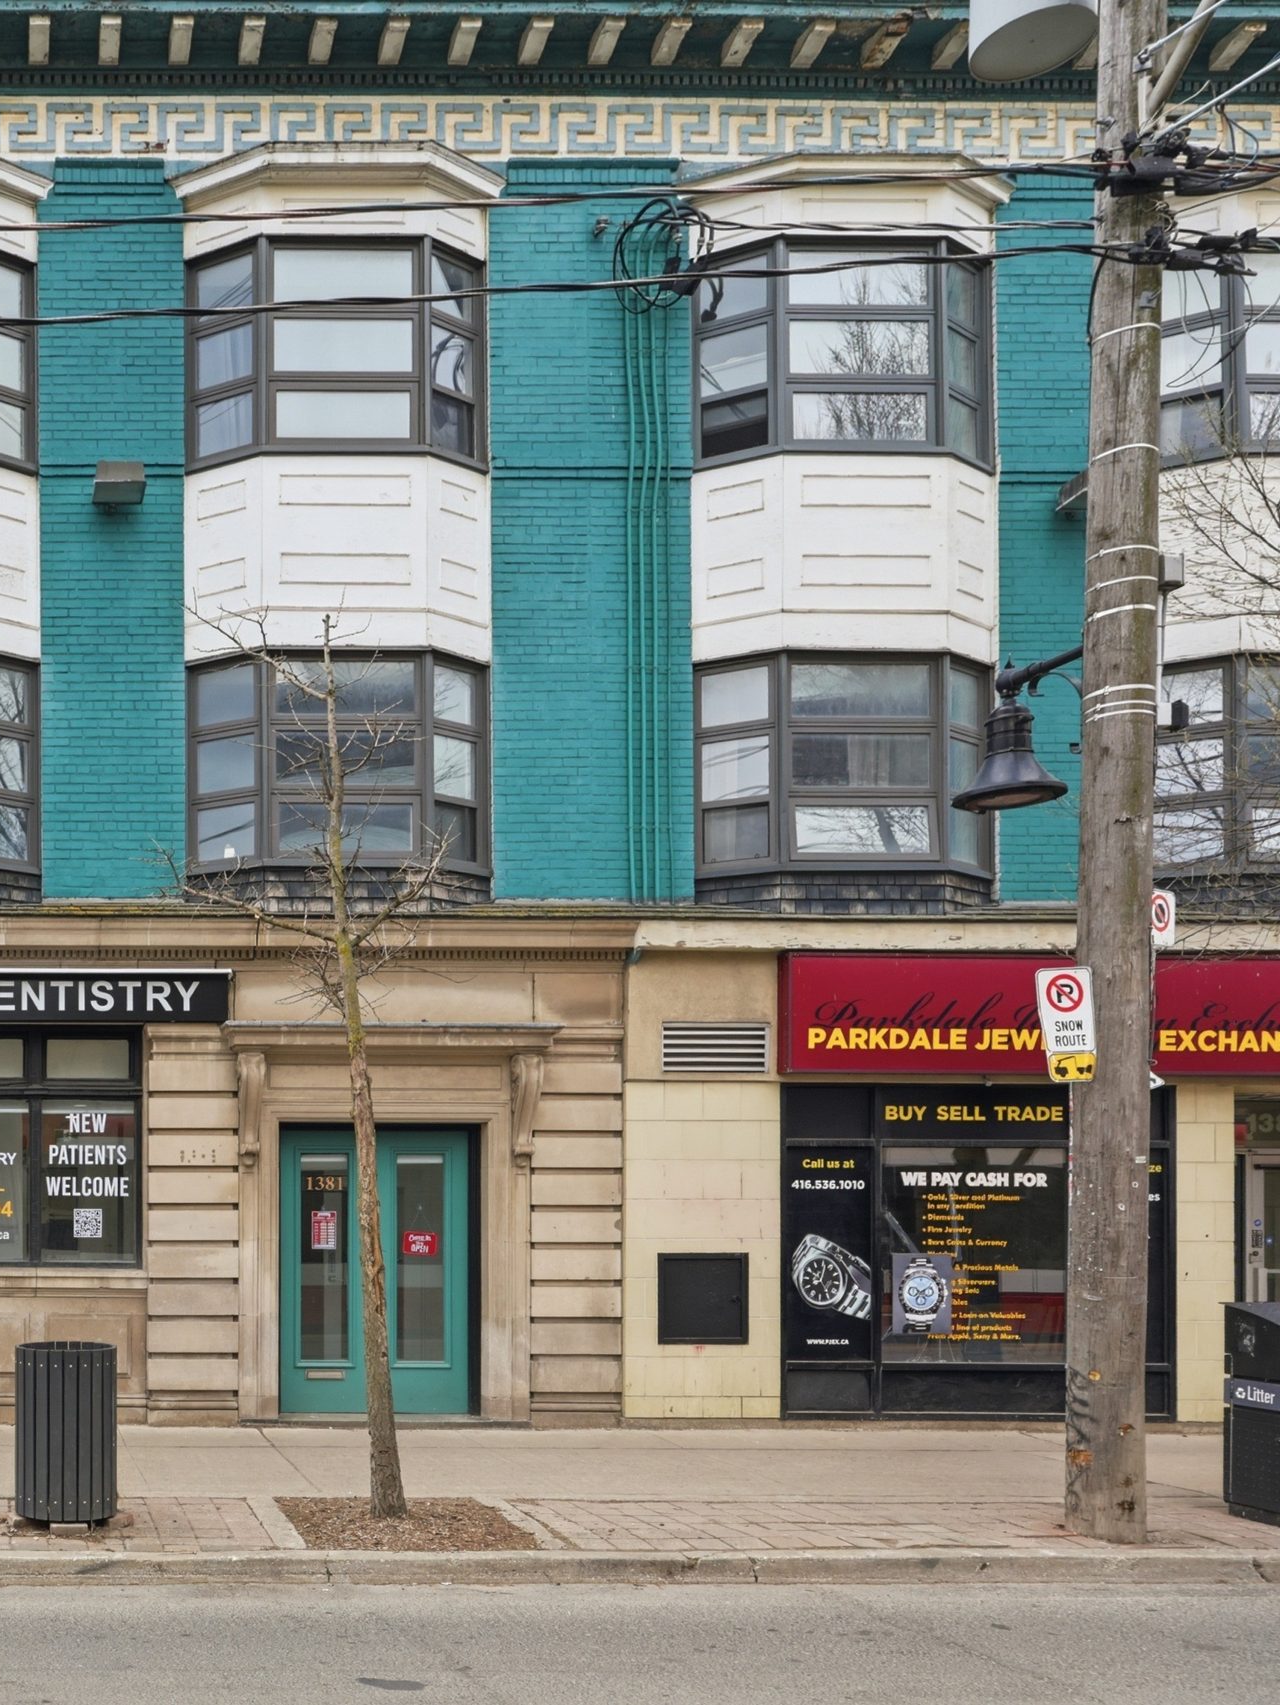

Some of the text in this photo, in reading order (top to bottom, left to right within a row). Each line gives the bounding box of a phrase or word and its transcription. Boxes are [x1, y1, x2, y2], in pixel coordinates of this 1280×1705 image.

[1054, 1020, 1084, 1032] SNOW
[807, 1027, 1280, 1053] PARKDALE JEW EXCHAN
[1054, 1034, 1087, 1047] ROUTE
[884, 1105, 1064, 1121] BUY SELL TRADE
[68, 1112, 107, 1133] NEW
[1248, 1112, 1280, 1133] 13
[48, 1144, 128, 1165] PATIENTS
[802, 1158, 855, 1168] Call us at
[45, 1176, 129, 1197] WELCOME
[306, 1175, 344, 1191] 1381
[791, 1179, 866, 1190] 416.536.1010
[900, 1171, 1048, 1188] WE PAY CASH FOR
[975, 1238, 1008, 1247] Currency
[1247, 1386, 1276, 1405] Litter
